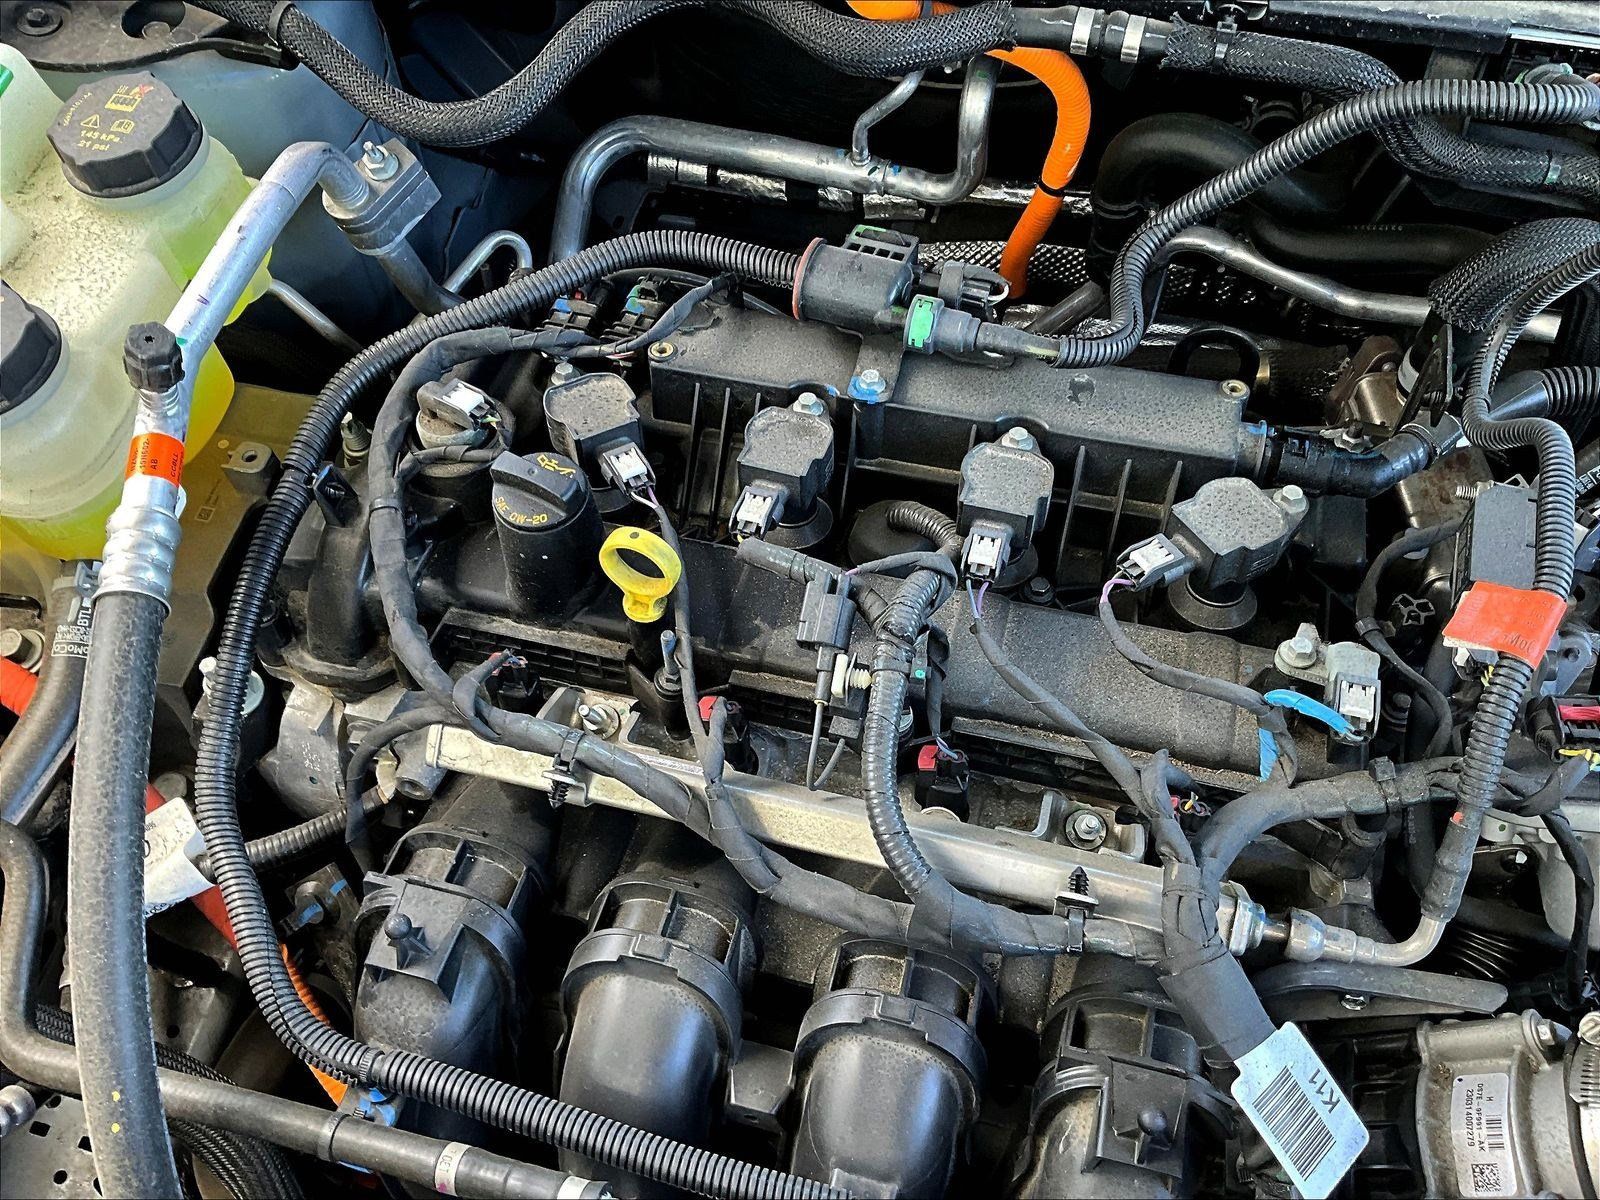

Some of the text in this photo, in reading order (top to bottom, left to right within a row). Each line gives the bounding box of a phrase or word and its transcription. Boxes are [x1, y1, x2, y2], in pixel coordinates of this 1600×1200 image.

[151, 458, 159, 470] AB
[495, 496, 509, 514] SAE
[1308, 1068, 1340, 1114] K11
[1465, 1089, 1476, 1147] 230314007279
